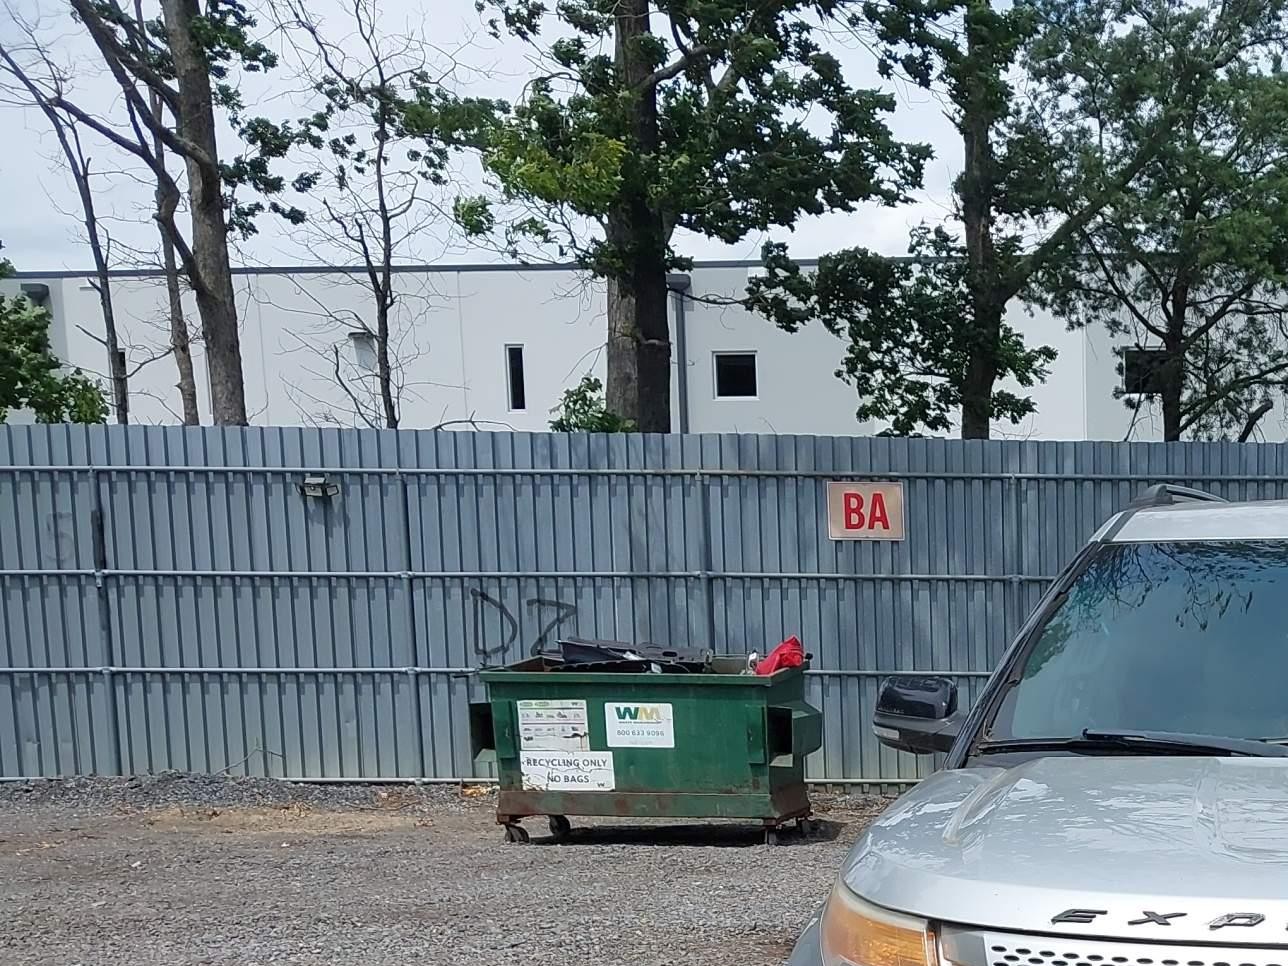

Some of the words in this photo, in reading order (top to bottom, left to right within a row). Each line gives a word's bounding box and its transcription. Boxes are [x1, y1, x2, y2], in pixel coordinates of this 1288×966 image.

[843, 492, 890, 531] BA
[614, 706, 662, 720] WM
[526, 758, 580, 768] RECYCLING
[582, 758, 607, 767] ONLY
[547, 773, 561, 783] NO
[563, 774, 590, 783] BAGS
